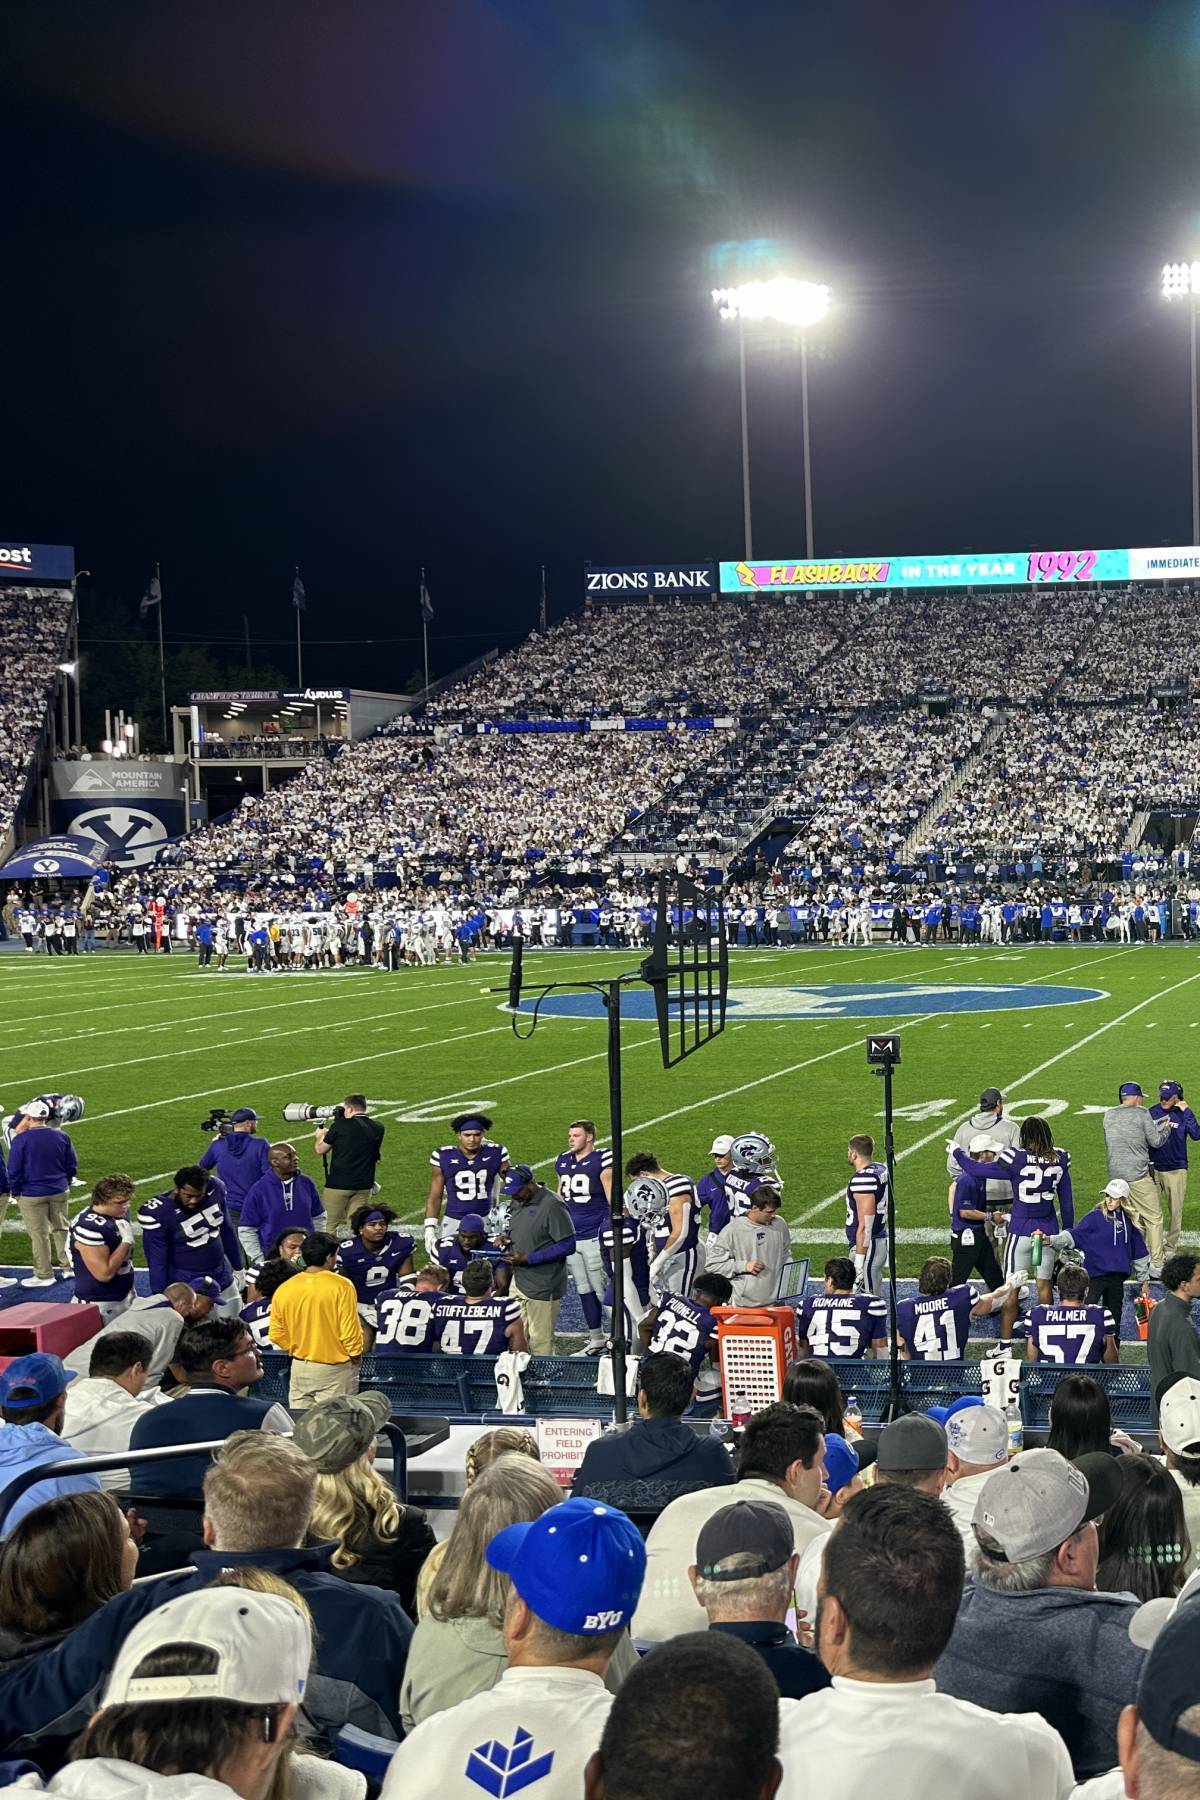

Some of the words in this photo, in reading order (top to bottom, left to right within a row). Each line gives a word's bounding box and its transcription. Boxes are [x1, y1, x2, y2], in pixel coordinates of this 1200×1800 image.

[769, 563, 882, 585] FLASHBACK
[902, 564, 921, 579] IN
[927, 563, 962, 578] THE
[966, 562, 1016, 577] YEAR
[1026, 551, 1098, 582] 1992
[586, 572, 649, 590] ZIONS
[653, 570, 710, 589] BANK
[304, 688, 344, 701] smarty
[111, 771, 162, 780] MOUNTAIN
[115, 780, 160, 789] AMERICA
[454, 1168, 488, 1201] 91
[1018, 1165, 1064, 1204] 23
[85, 1213, 107, 1226] 93
[180, 1202, 225, 1248] 55
[435, 1304, 502, 1318] STUFFLEBEAN
[665, 1297, 701, 1325] PURNELL
[811, 1297, 856, 1309] ROMAINE
[914, 1297, 949, 1316] MOORE
[375, 1299, 432, 1346] 38
[1045, 1309, 1087, 1322] PALMER
[440, 1319, 495, 1355] 47
[647, 1309, 701, 1362] 32
[806, 1309, 862, 1356] 45
[913, 1309, 961, 1361] 41
[1037, 1324, 1097, 1364] 57
[992, 1360, 1006, 1376] G
[1008, 1379, 1020, 1394] G
[545, 1427, 593, 1437] ENTERING
[555, 1439, 583, 1448] FIELD
[583, 1609, 622, 1630] BYU
